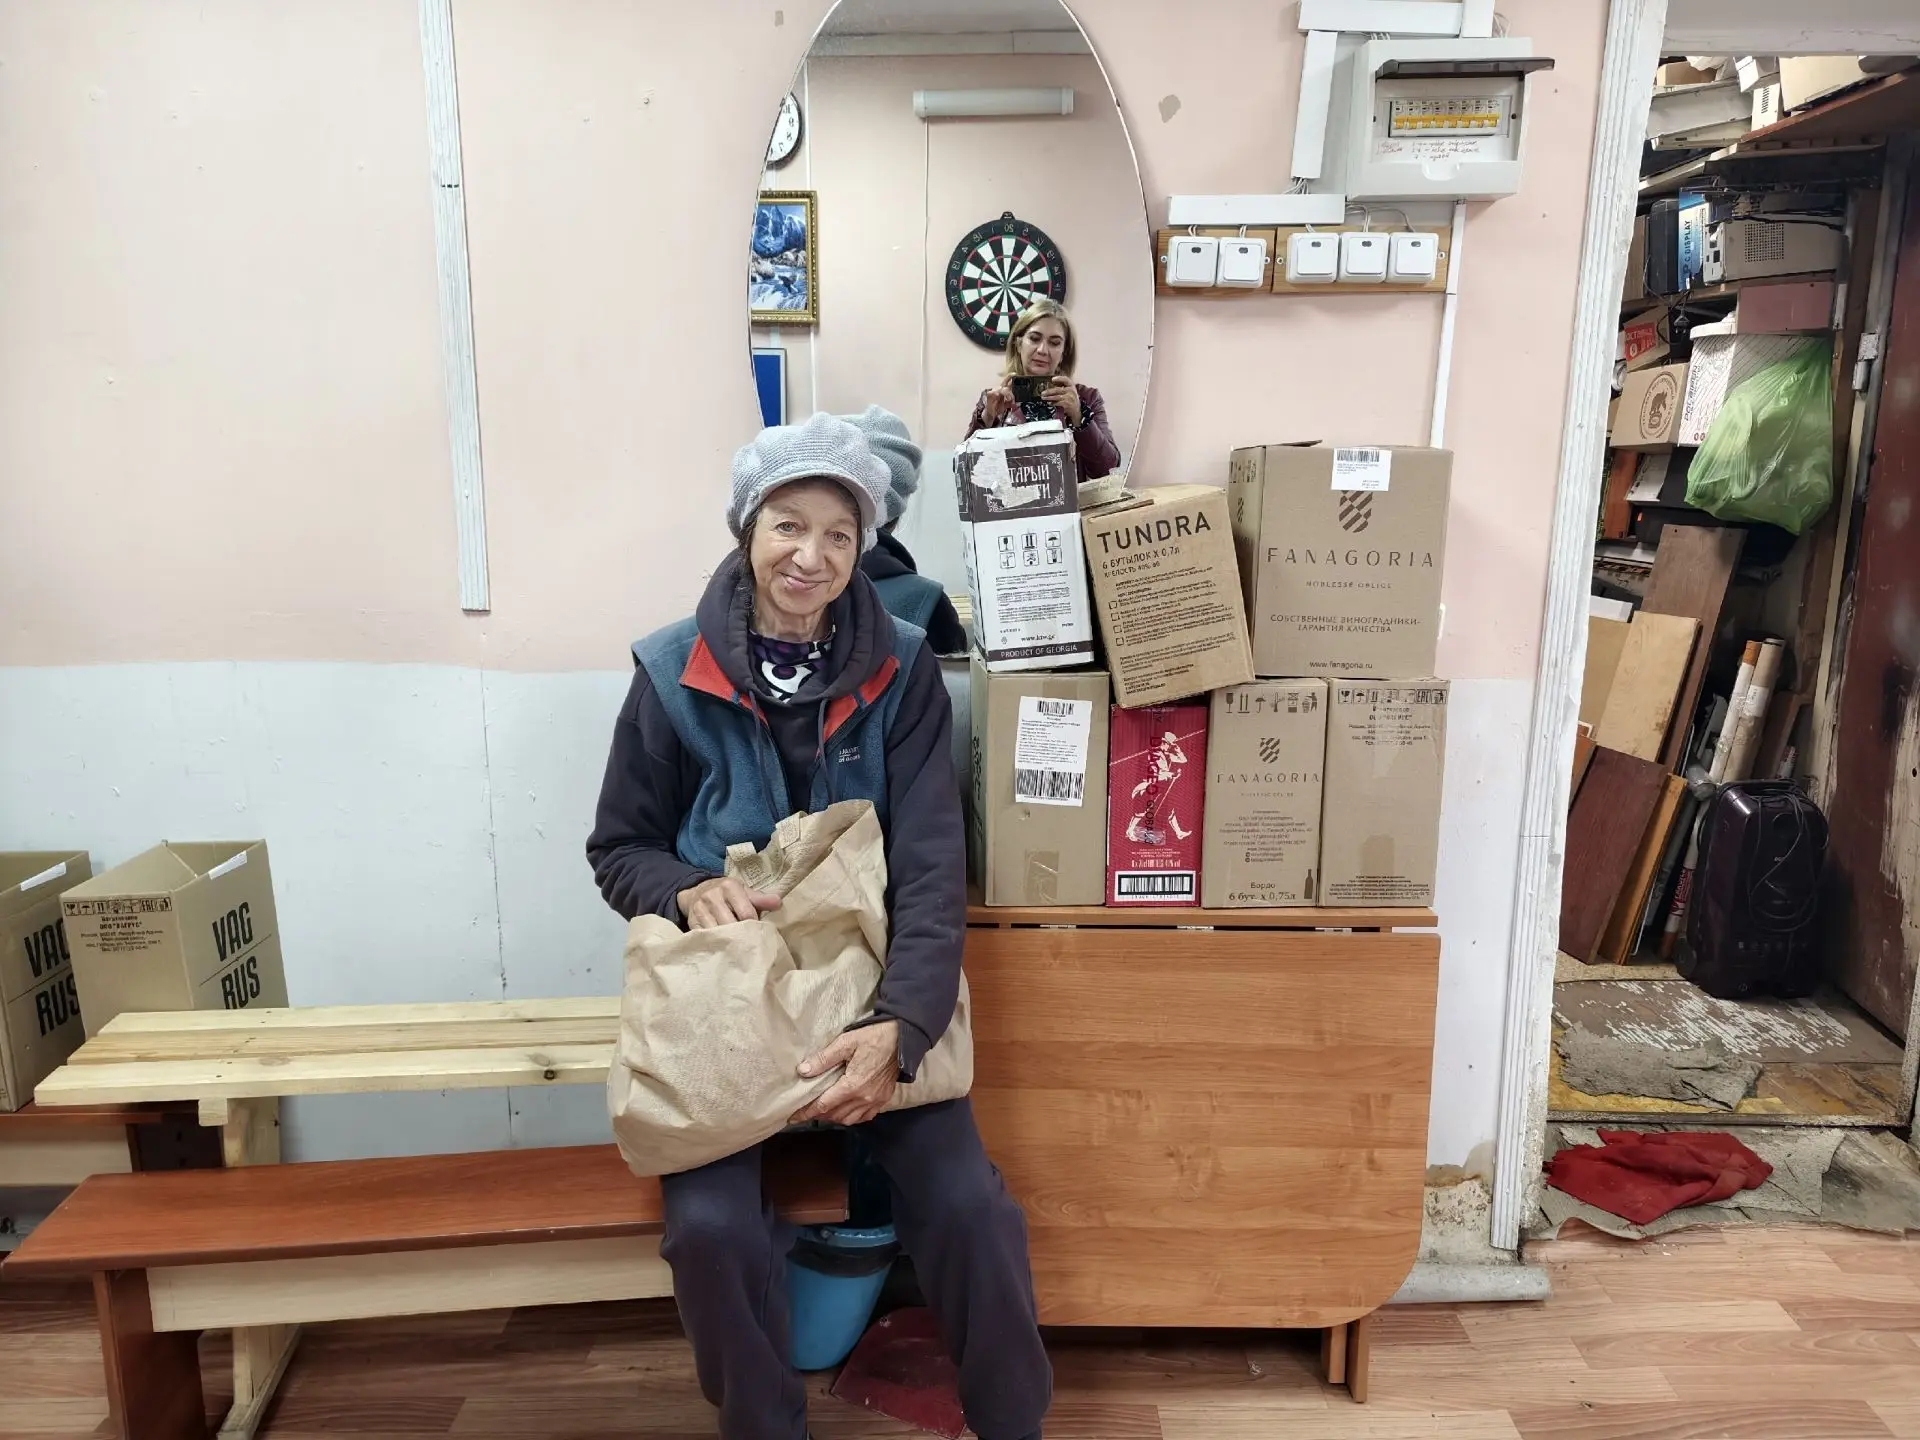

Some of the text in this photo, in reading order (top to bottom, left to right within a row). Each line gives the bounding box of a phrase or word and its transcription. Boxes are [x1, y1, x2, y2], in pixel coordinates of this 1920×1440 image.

[1683, 220, 1691, 254] DISPLAY
[1008, 463, 1050, 484] ТАРЫЙ
[1096, 511, 1212, 553] TUNDRA
[1102, 560, 1108, 569] 6
[1110, 551, 1152, 568] БУТЫЛОК
[1267, 547, 1434, 568] FANAGORIA
[1270, 614, 1337, 624] СОБСТВЕННЫЕ
[1297, 624, 1392, 633] ГАРАНТИЯ КАЧЕСТВА
[1000, 643, 1078, 658] PRODUCT OF GEORGIA
[1216, 773, 1320, 784] FANAGORIA
[1250, 882, 1276, 890] Бордо
[1228, 893, 1235, 901] 6
[1269, 892, 1297, 901] 0,75л
[221, 955, 262, 1009] RUS
[35, 973, 81, 1037] RUS
